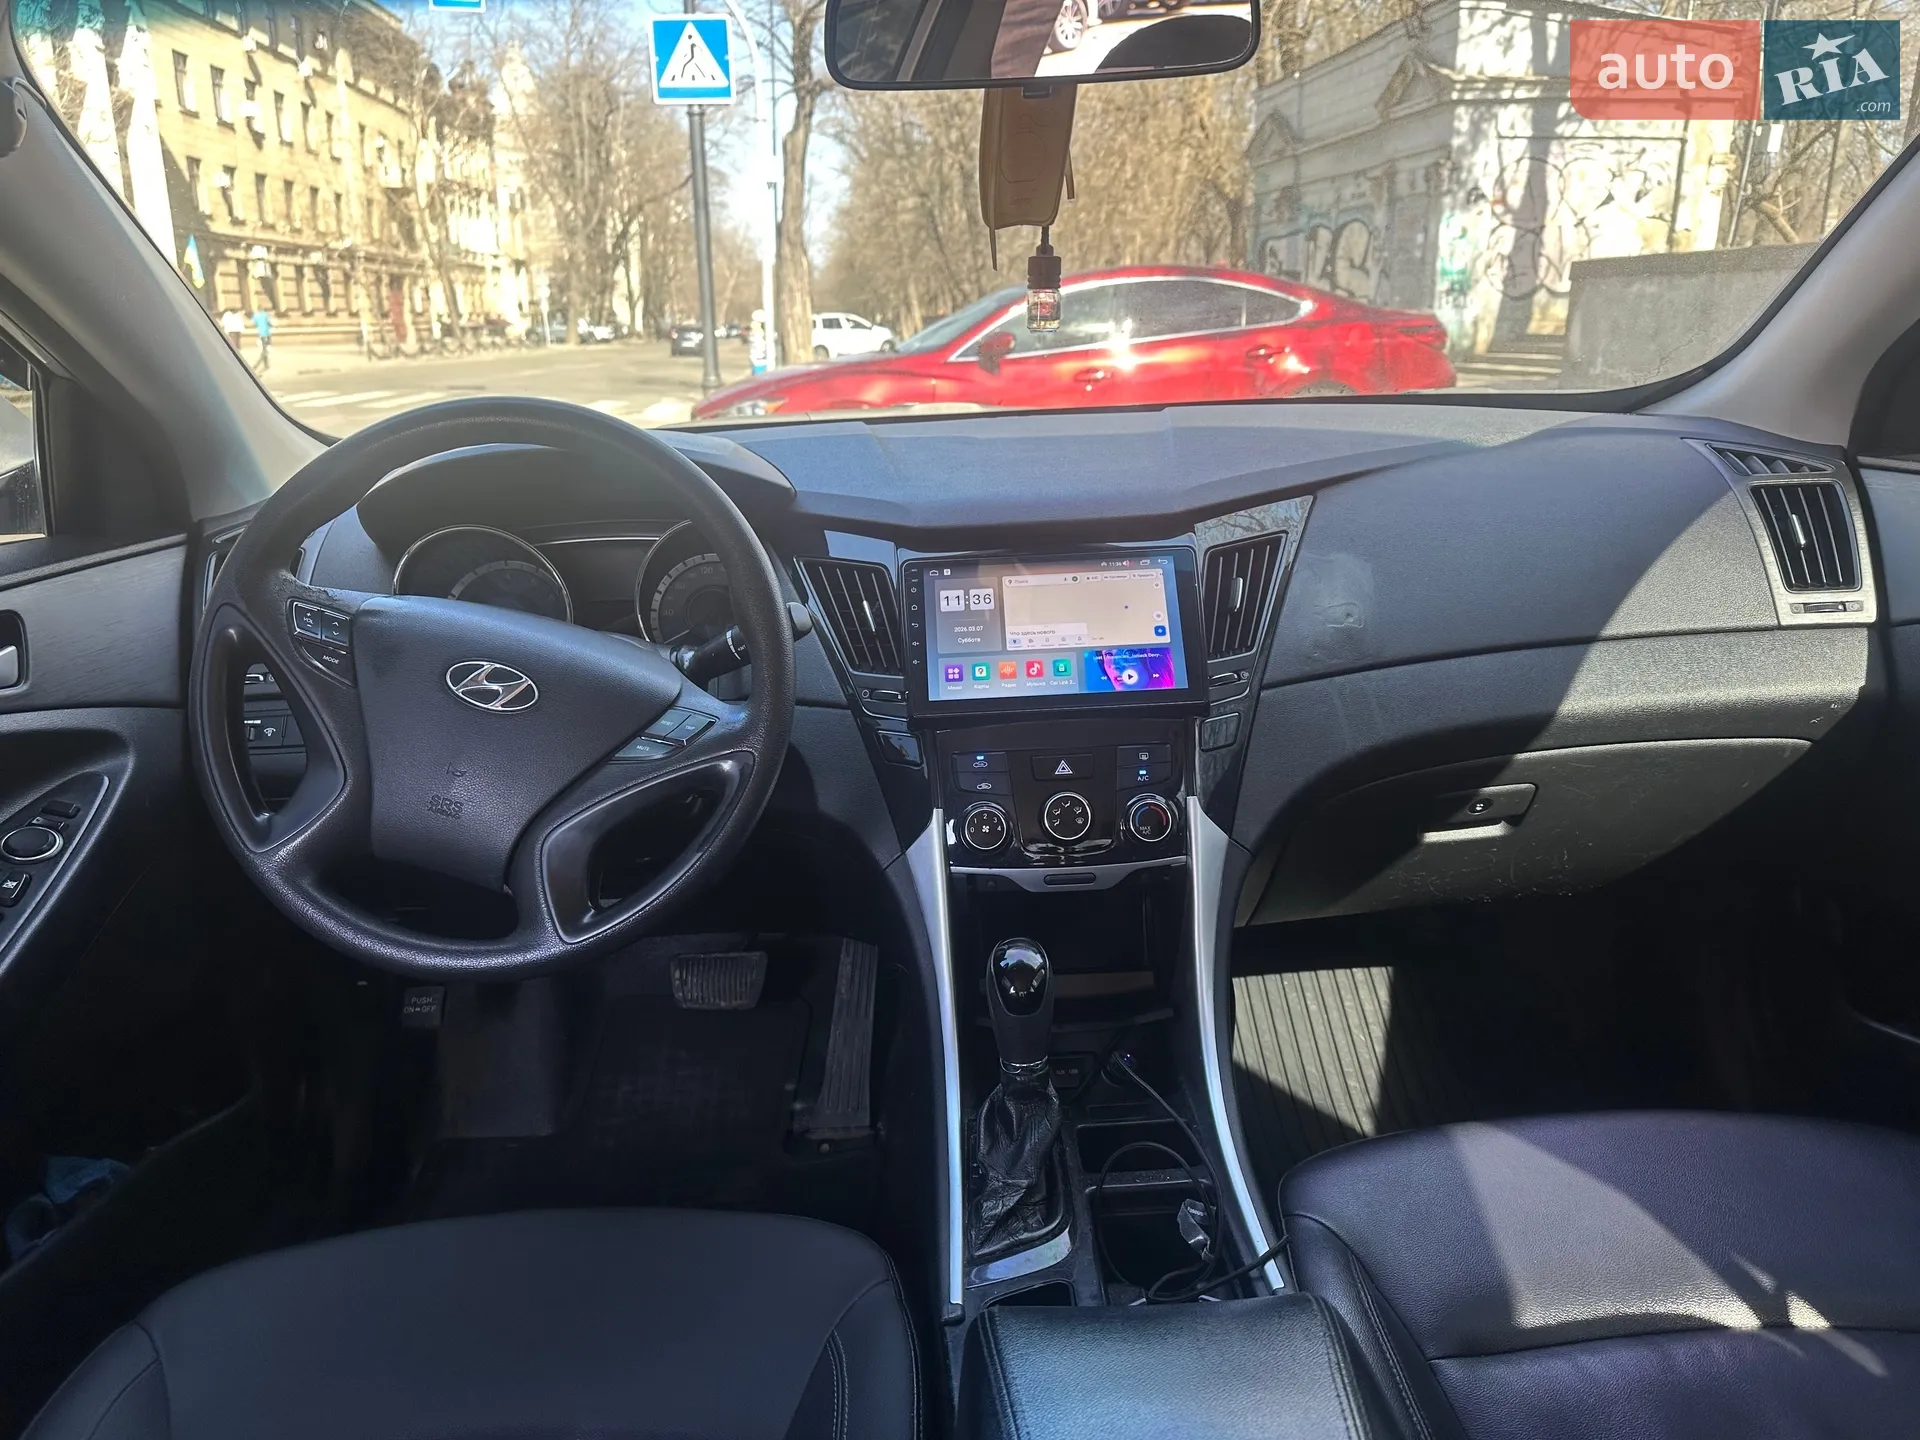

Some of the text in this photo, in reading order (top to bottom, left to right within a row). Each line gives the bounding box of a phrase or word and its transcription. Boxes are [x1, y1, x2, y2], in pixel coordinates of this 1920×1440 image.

[303, 616, 314, 625] VOL
[322, 655, 340, 665] MODE
[430, 795, 464, 813] SRS
[411, 996, 433, 1004] PUSH
